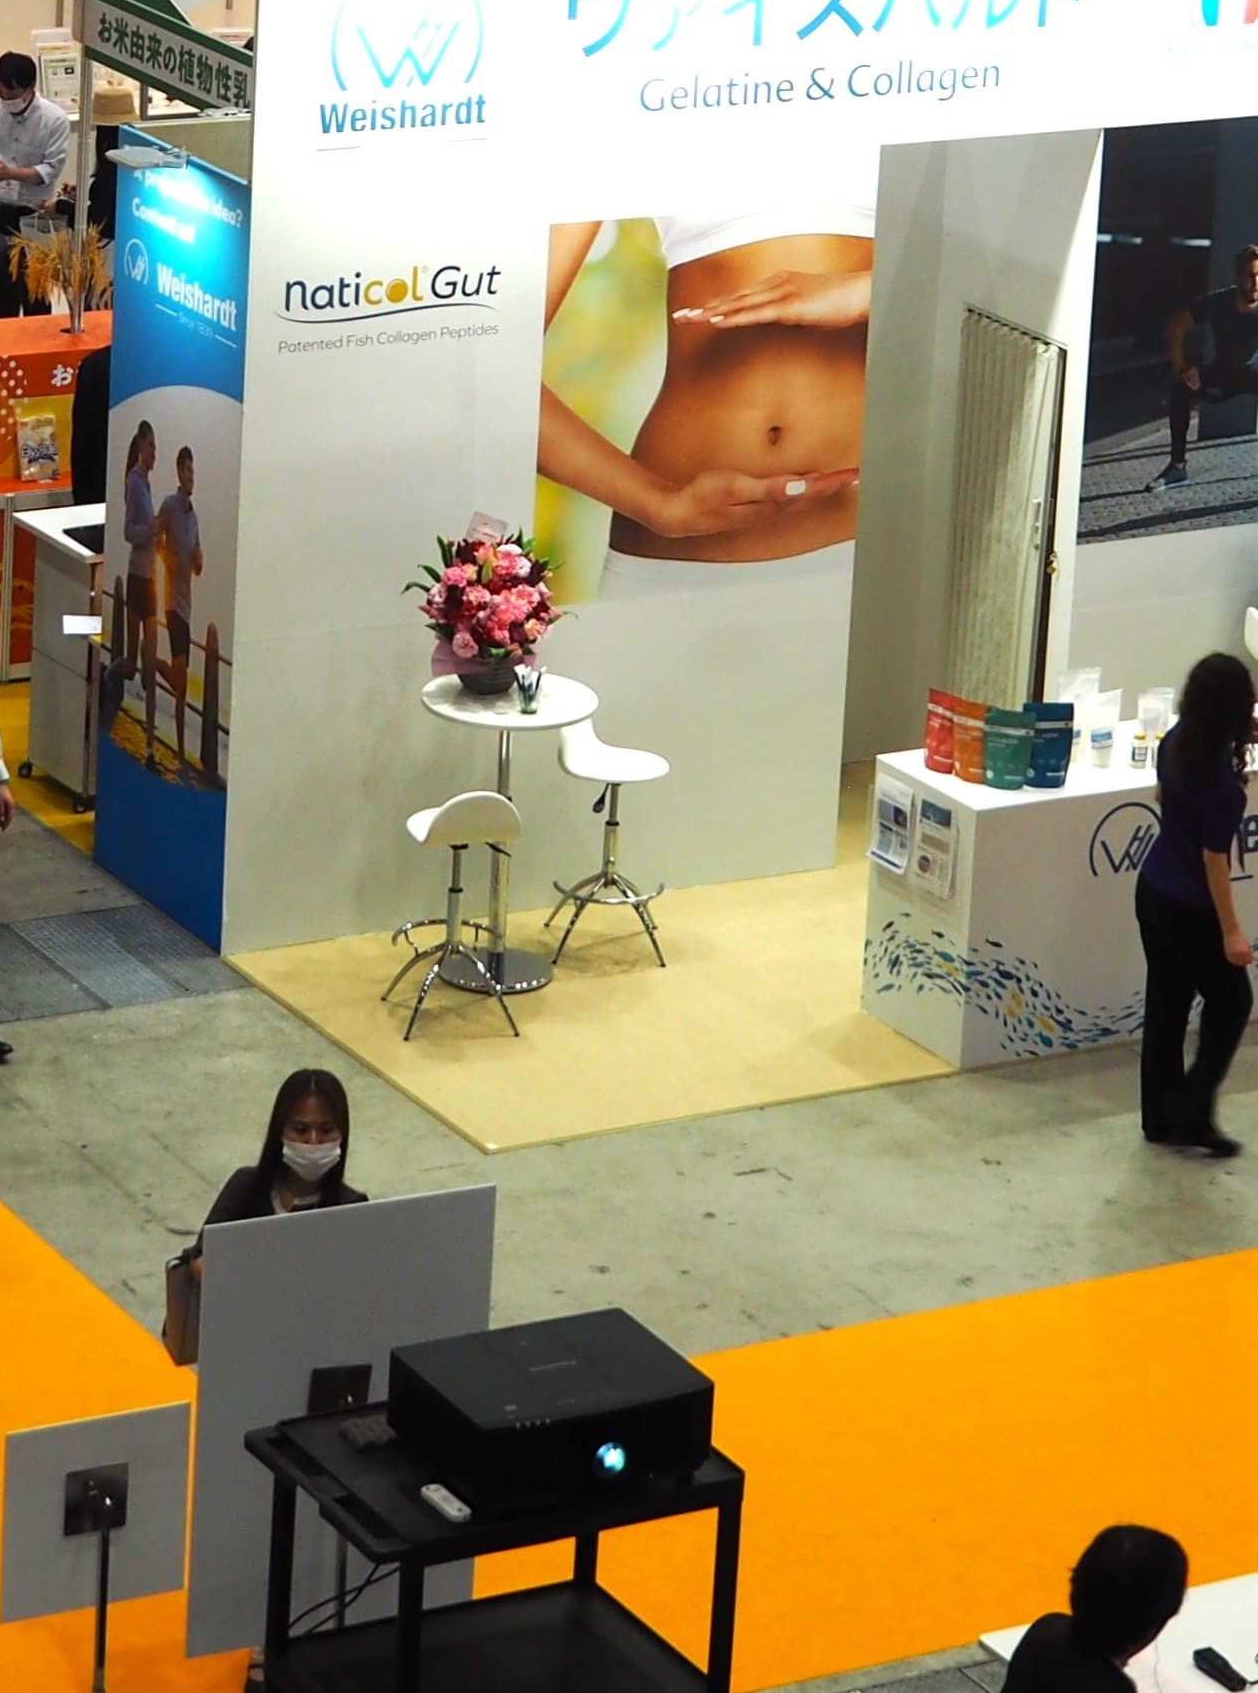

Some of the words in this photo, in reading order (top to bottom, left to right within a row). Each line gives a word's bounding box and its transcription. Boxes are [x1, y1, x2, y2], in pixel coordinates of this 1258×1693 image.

[98, 11, 253, 110] お米由来の植物性乳
[639, 72, 795, 112] Gelatine
[805, 66, 836, 101] &
[847, 60, 1001, 102] Collagen
[318, 96, 487, 136] Weishardt
[156, 261, 238, 332] Weishardt
[284, 265, 424, 312] naticol
[430, 265, 502, 299] Gut
[278, 335, 343, 354] Patented
[346, 333, 374, 348] Fish
[376, 329, 437, 346] Collagen
[440, 323, 499, 341] Peptides
